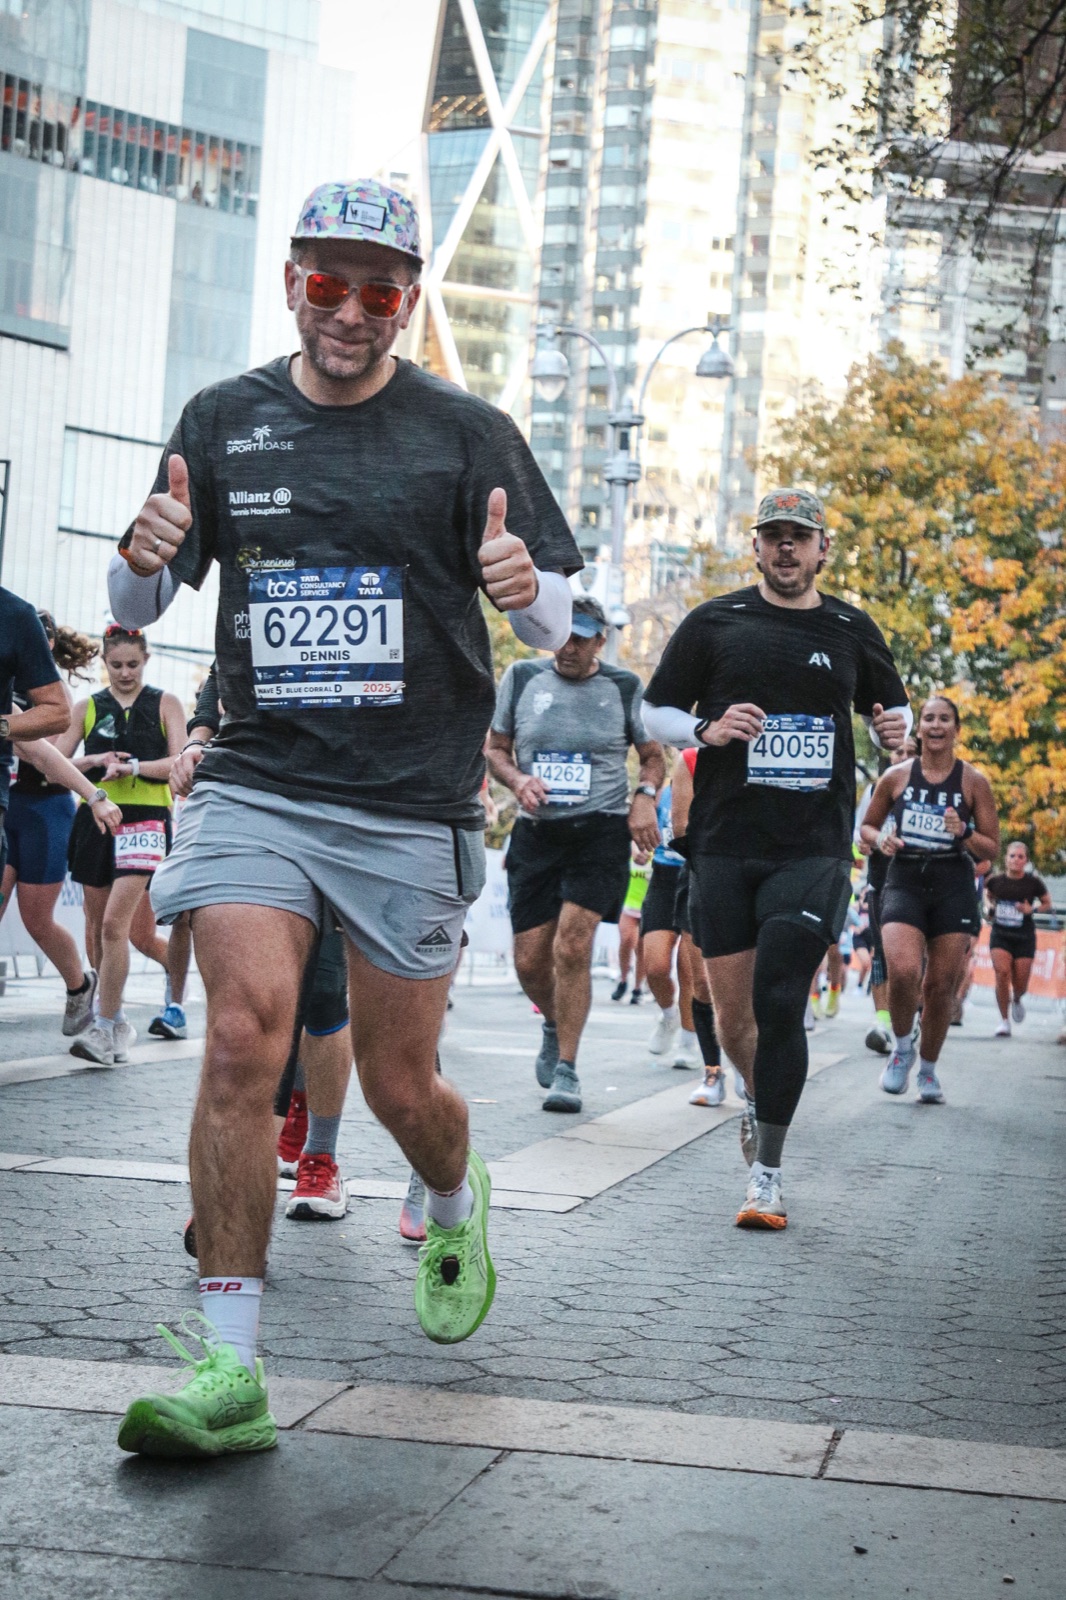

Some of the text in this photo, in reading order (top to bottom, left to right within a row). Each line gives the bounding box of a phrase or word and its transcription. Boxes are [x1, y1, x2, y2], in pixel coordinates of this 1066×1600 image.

[226, 443, 259, 455] SPORT
[264, 441, 294, 450] OASE
[228, 491, 271, 504] Allianz
[267, 578, 298, 598] tcs
[300, 581, 347, 589] CONSULTANCY
[357, 587, 384, 595] TATA
[263, 603, 388, 649] 62291
[300, 649, 351, 662] DENNIS
[275, 685, 282, 695] 5
[303, 685, 333, 693] CORRAL
[334, 684, 343, 693] D
[363, 683, 392, 693] 2025
[353, 696, 362, 706] B
[753, 734, 829, 758] 40055
[537, 765, 585, 782] 14262
[903, 786, 963, 808] STEF
[908, 814, 945, 833] 4182
[119, 832, 166, 850] 24639
[199, 1281, 243, 1294] cep
